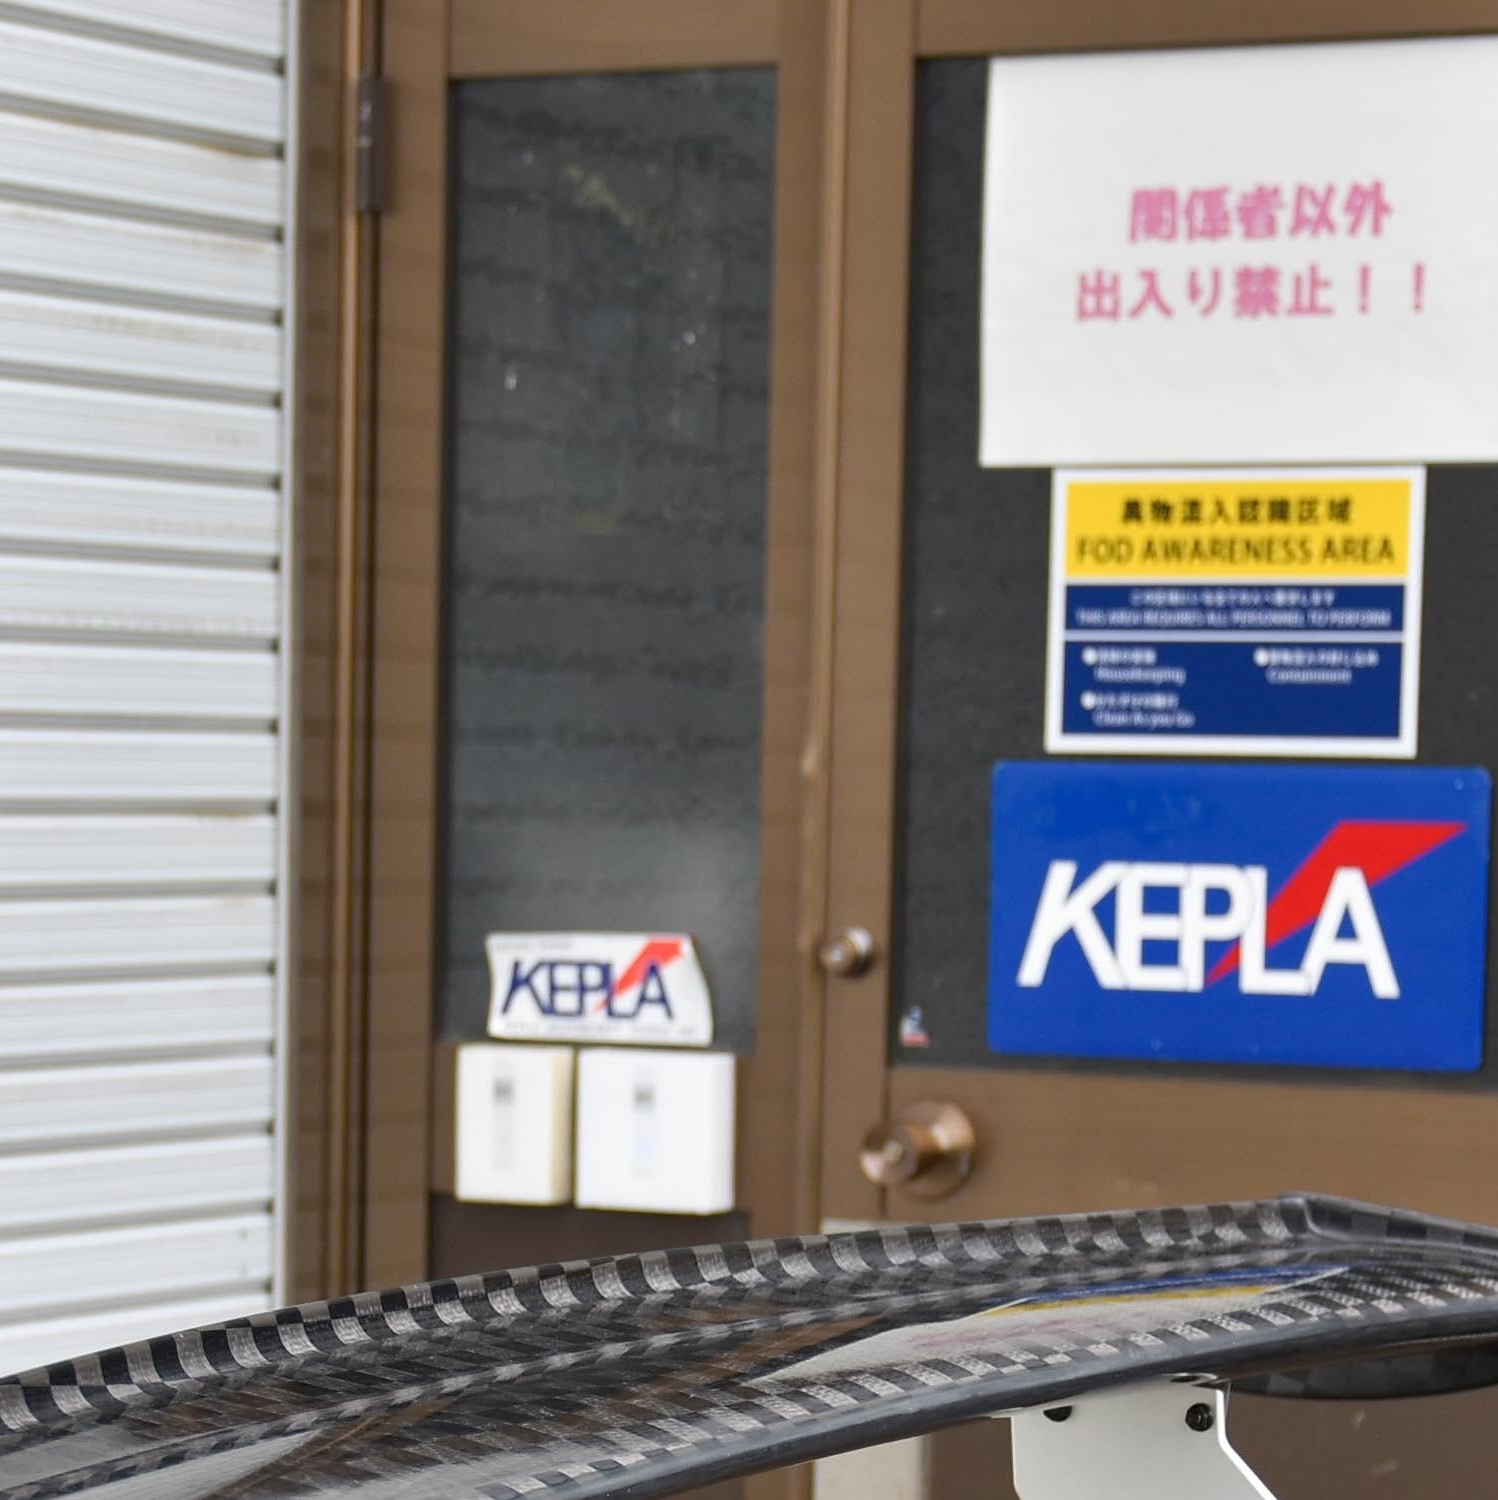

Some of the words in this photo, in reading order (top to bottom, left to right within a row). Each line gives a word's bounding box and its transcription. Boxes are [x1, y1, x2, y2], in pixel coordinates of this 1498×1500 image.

[1128, 180, 1393, 244] 関係者以外
[1076, 536, 1134, 567] FOD
[1143, 535, 1313, 566] AWARENESS
[1321, 534, 1396, 565] AREA
[1017, 859, 1401, 999] KEPLA
[502, 960, 673, 1020] KEPLA
